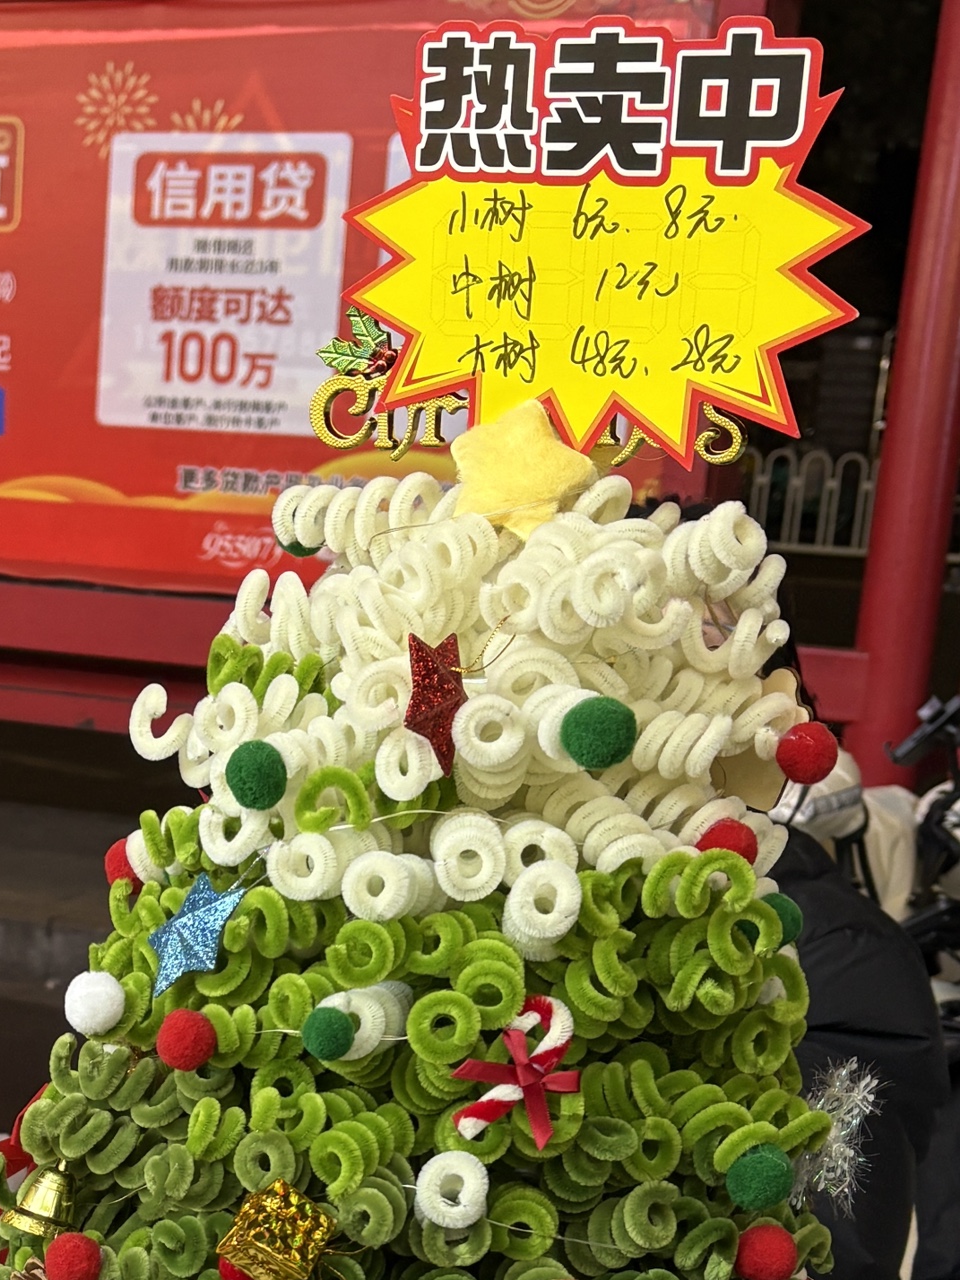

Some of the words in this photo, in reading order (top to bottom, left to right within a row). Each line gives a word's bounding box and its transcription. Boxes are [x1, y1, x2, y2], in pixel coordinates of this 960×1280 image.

[417, 27, 811, 177] 热卖中
[145, 159, 316, 221] 信用贷
[449, 188, 533, 242] 小树
[149, 284, 295, 325] 额度可达
[451, 254, 536, 321] 中树
[159, 330, 277, 389] 100万
